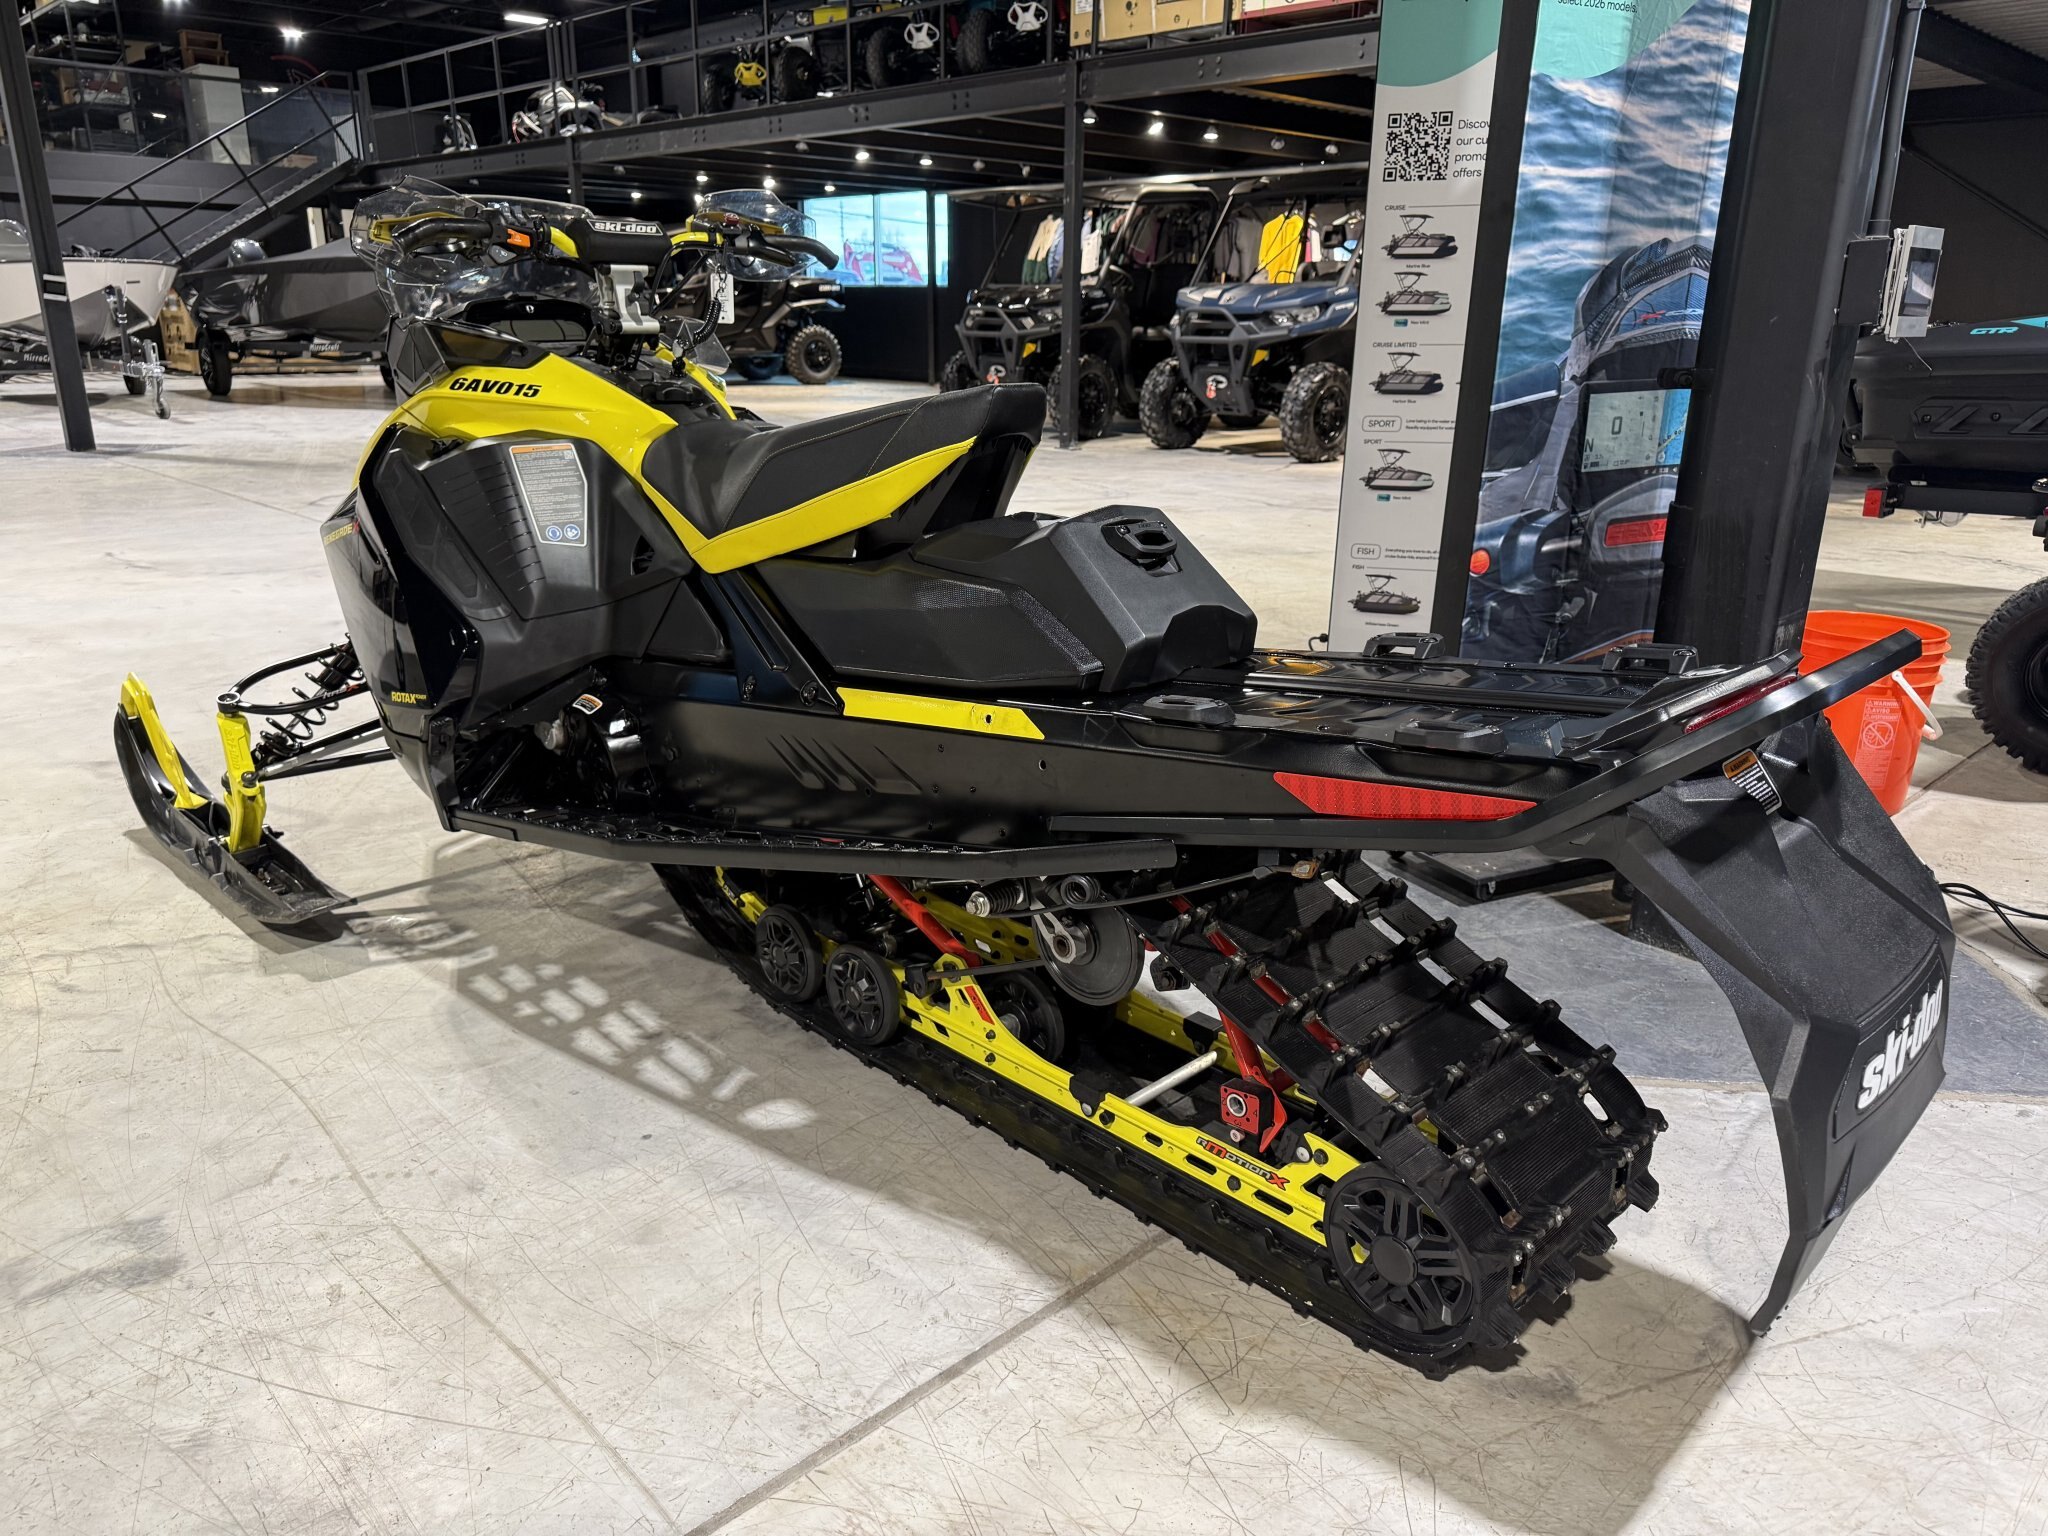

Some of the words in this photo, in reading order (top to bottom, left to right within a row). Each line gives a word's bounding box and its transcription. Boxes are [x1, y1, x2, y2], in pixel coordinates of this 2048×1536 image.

[1584, 0, 1605, 9] 2026
[1606, 2, 1638, 13] models.
[1458, 119, 1490, 130] Discov
[1456, 137, 1474, 146] our
[1475, 137, 1488, 145] cu
[1454, 153, 1487, 165] promo
[1452, 167, 1482, 178] offers
[594, 222, 657, 234] ski-doo
[1970, 326, 2020, 335] GTR
[23, 353, 50, 362] MirroCr
[1368, 420, 1396, 428] SPORT
[1357, 547, 1375, 555] FISH
[391, 691, 416, 704] ROTAX
[1857, 979, 1943, 1110] ski-doo
